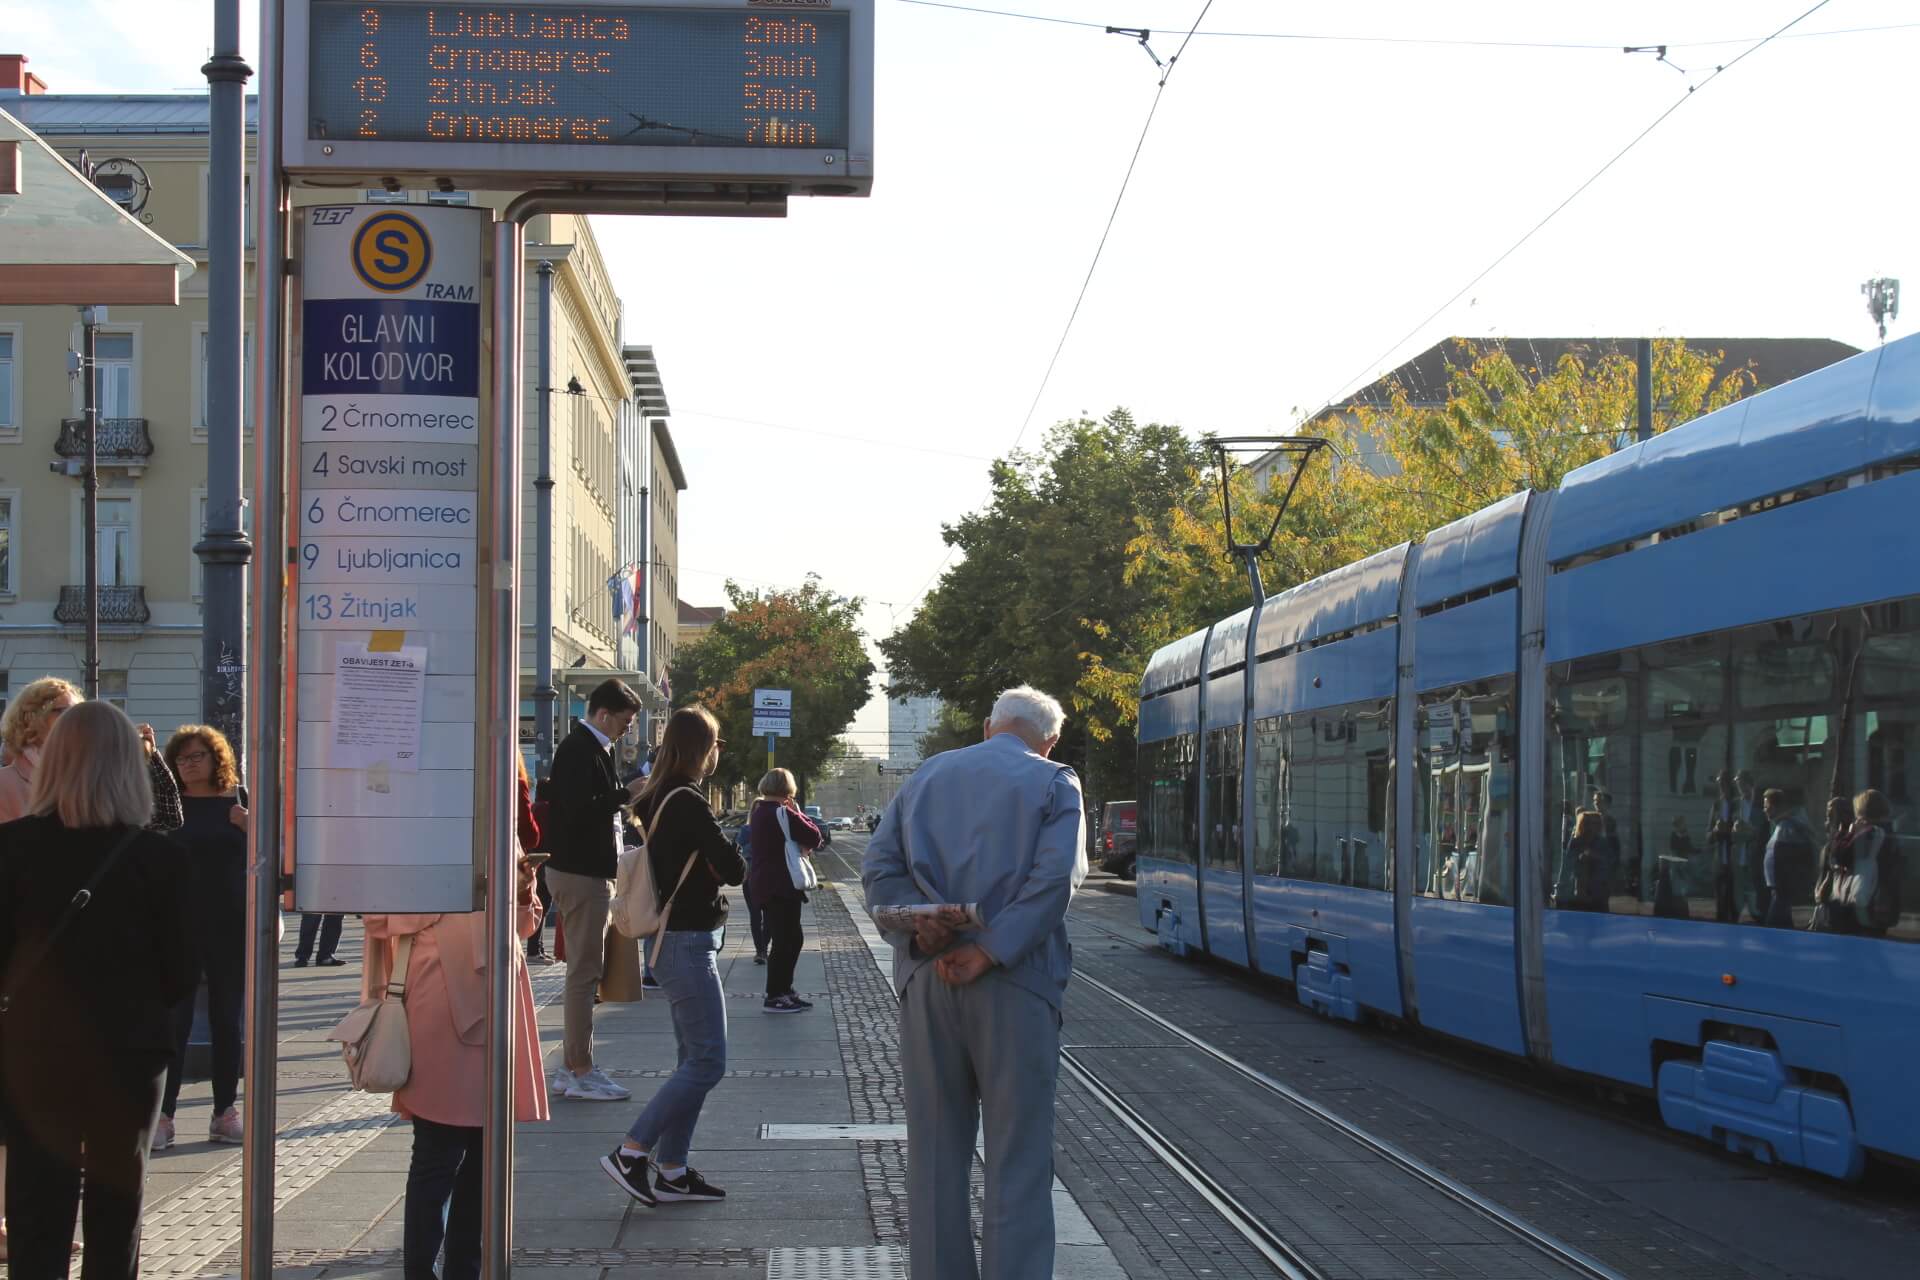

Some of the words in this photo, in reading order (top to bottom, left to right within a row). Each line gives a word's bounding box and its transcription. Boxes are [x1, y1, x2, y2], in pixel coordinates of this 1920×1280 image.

[361, 9, 379, 35] 9
[744, 16, 817, 44] 2min
[361, 43, 379, 69] 6
[428, 44, 611, 73] Črnomerec
[744, 50, 817, 78] 3min
[352, 76, 387, 103] 13
[743, 84, 817, 112] 5min
[360, 110, 377, 136] 2
[427, 110, 611, 141] Črnomerec
[743, 117, 817, 145] 7min
[373, 229, 410, 274] S
[425, 283, 474, 301] TRAM
[341, 313, 436, 345] GLAVNI
[323, 351, 454, 382] KOLODVOR
[320, 404, 338, 432] 2
[342, 402, 475, 430] Črnomerec
[312, 451, 329, 478] 4
[337, 454, 405, 475] Savski
[412, 458, 468, 477] most
[307, 497, 325, 524] 6
[337, 495, 471, 524] Črnomerec
[302, 543, 320, 570] 9
[336, 548, 462, 573] Ljubljanica
[304, 594, 333, 621] 13
[339, 592, 417, 623] Žitnjak
[342, 656, 389, 667] OBAVIJEST
